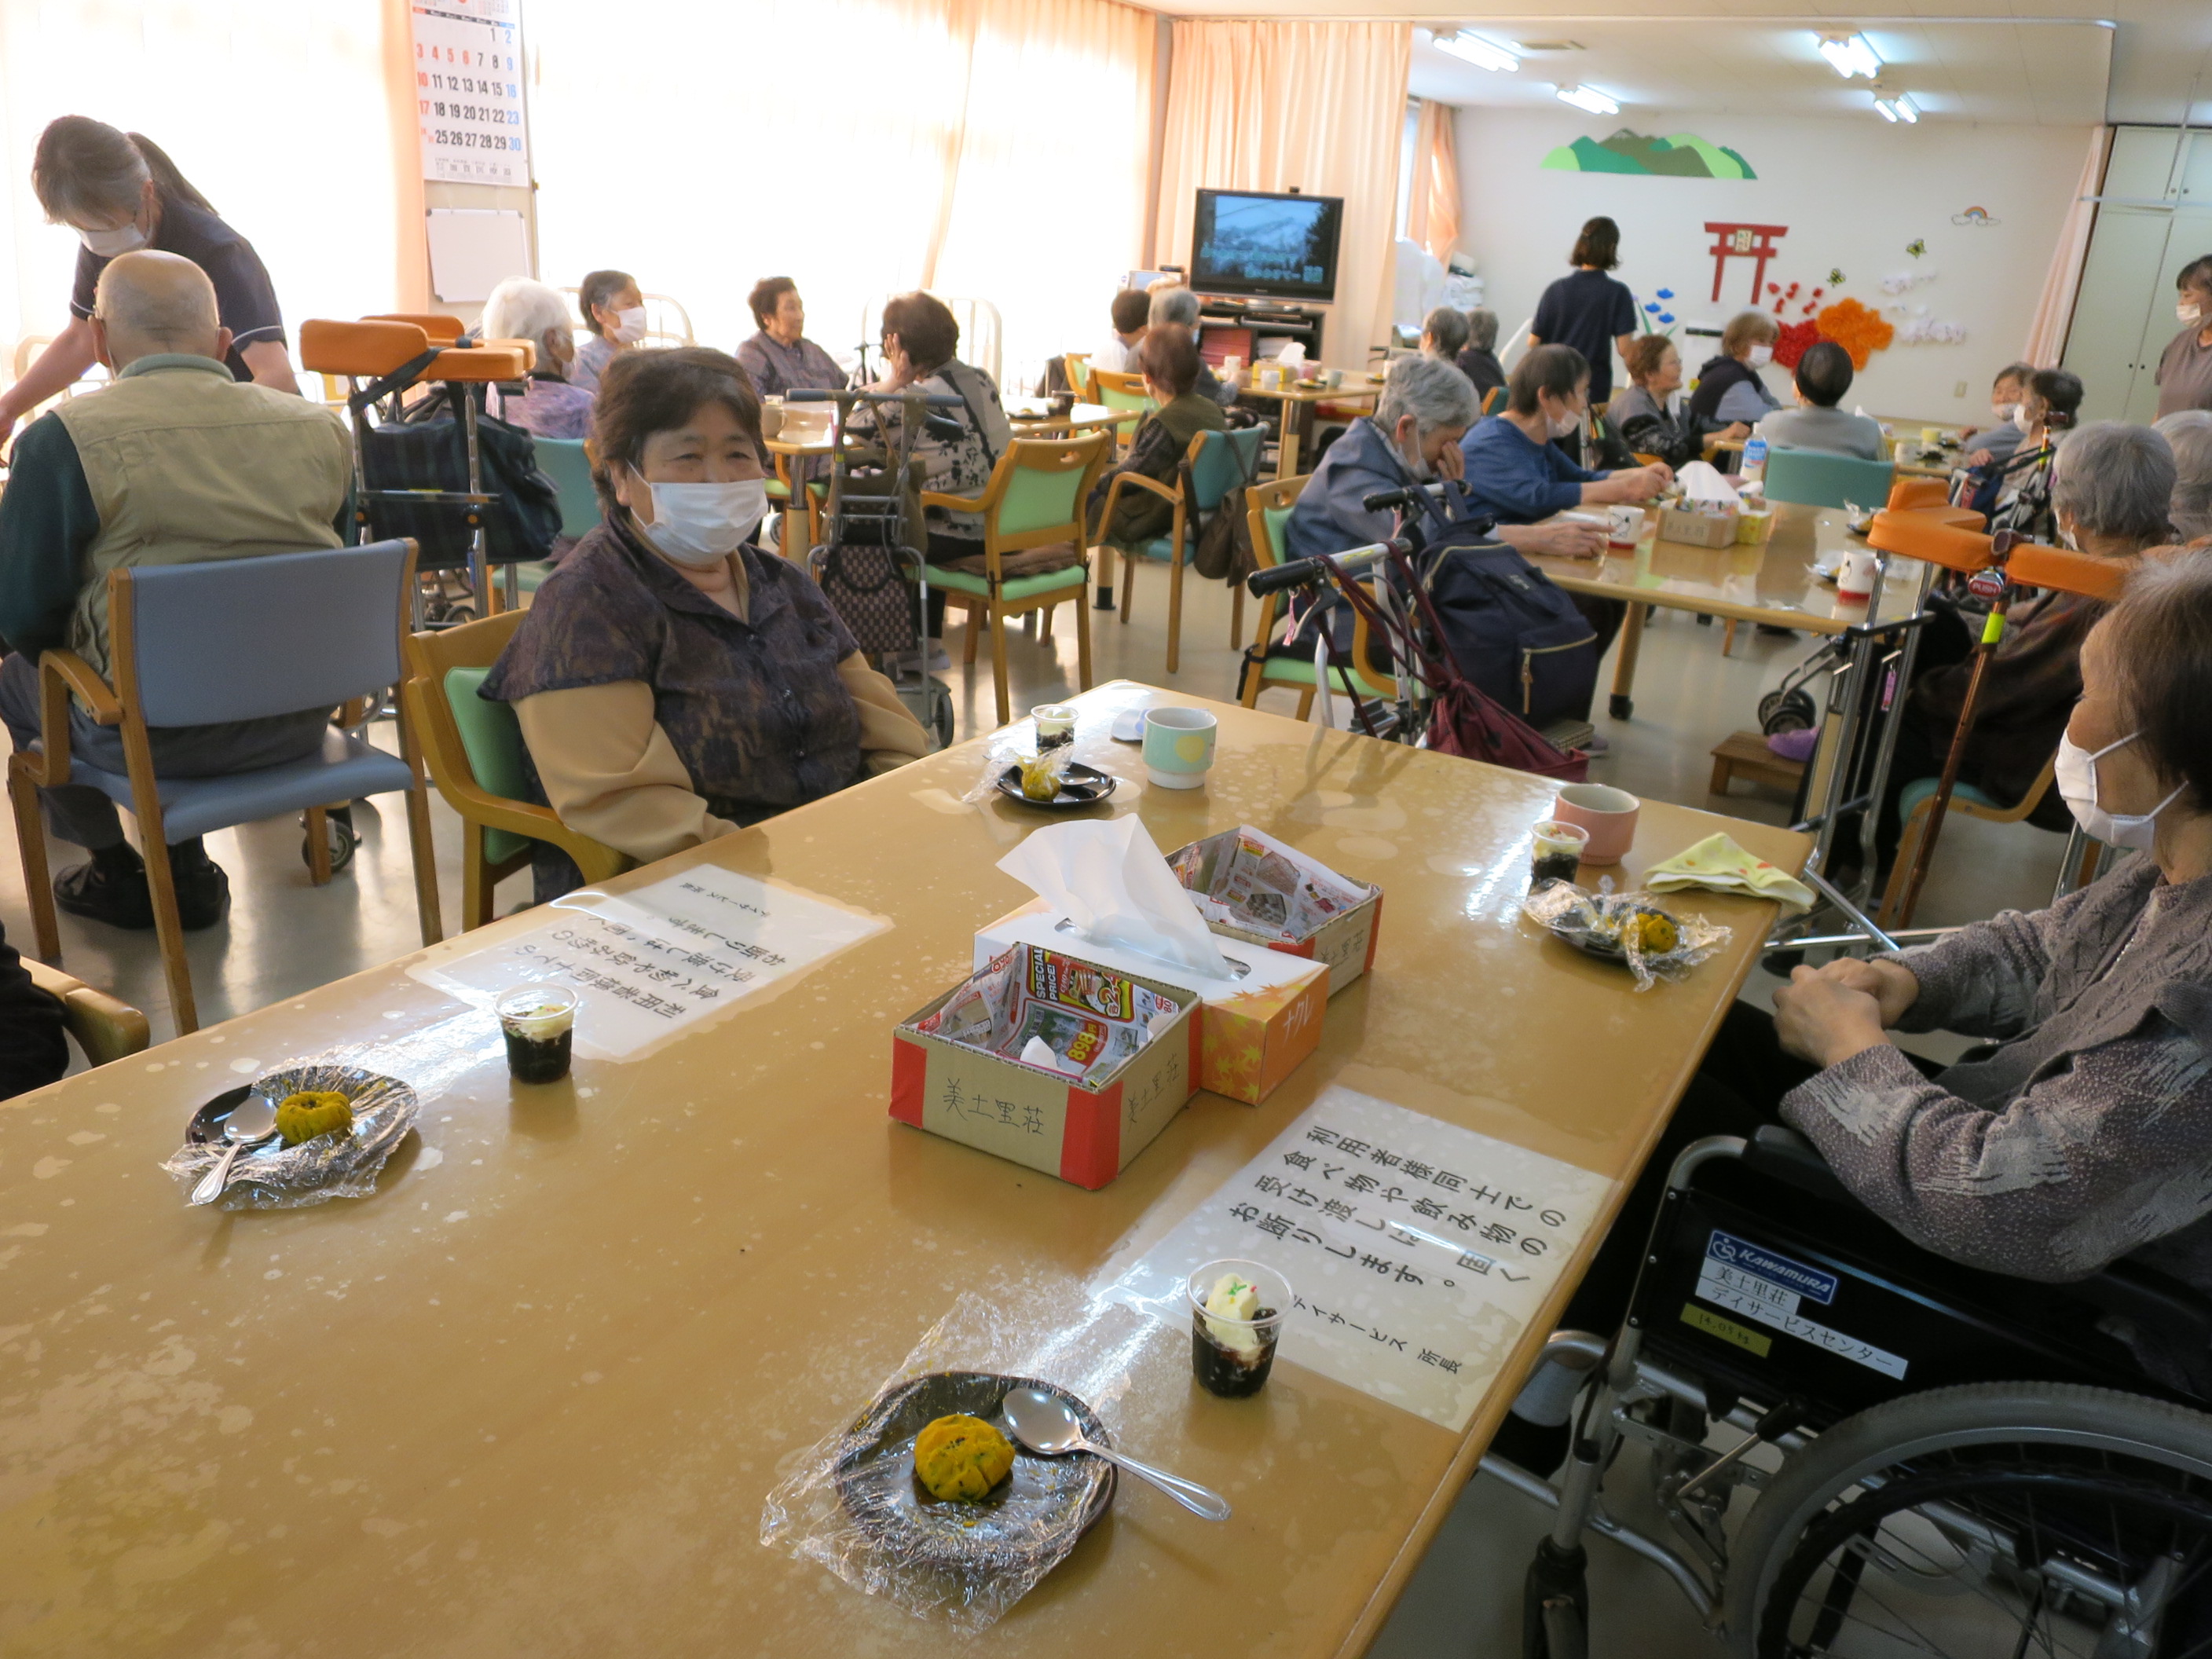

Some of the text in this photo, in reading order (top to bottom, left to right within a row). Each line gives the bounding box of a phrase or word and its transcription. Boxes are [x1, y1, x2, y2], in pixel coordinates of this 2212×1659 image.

[416, 43, 513, 71] 3 4 5 6 7 8 9
[490, 28, 511, 44] 1 2
[417, 71, 516, 99] 10 11 12 13 14 15 16
[419, 100, 519, 125] 17 18 19 20 21 22 23
[435, 130, 448, 145] 25
[450, 131, 463, 146] 26
[465, 133, 477, 148] 27
[480, 134, 492, 148] 28
[494, 136, 507, 150] 29
[508, 137, 522, 151] 30
[1972, 582, 1997, 594] PUSH
[552, 930, 720, 1000] 食べ物や飲み物の
[1034, 947, 1046, 999] SPECIAL
[1047, 964, 1058, 1002] PRICE!
[943, 1077, 1044, 1137] 美土里荘
[1127, 1052, 1179, 1128] 美土里荘
[1306, 1125, 1567, 1228] 利用者様同士での
[1283, 1151, 1547, 1257] 食べ物や飲み物の
[1229, 1203, 1456, 1288] お断りします。
[1715, 1265, 1789, 1308] 美土里荘
[1738, 1248, 1833, 1294] KAWAMURA
[1293, 1294, 1463, 1375] デイサービス 所長
[1712, 1285, 1894, 1368] デイサービスセンター
